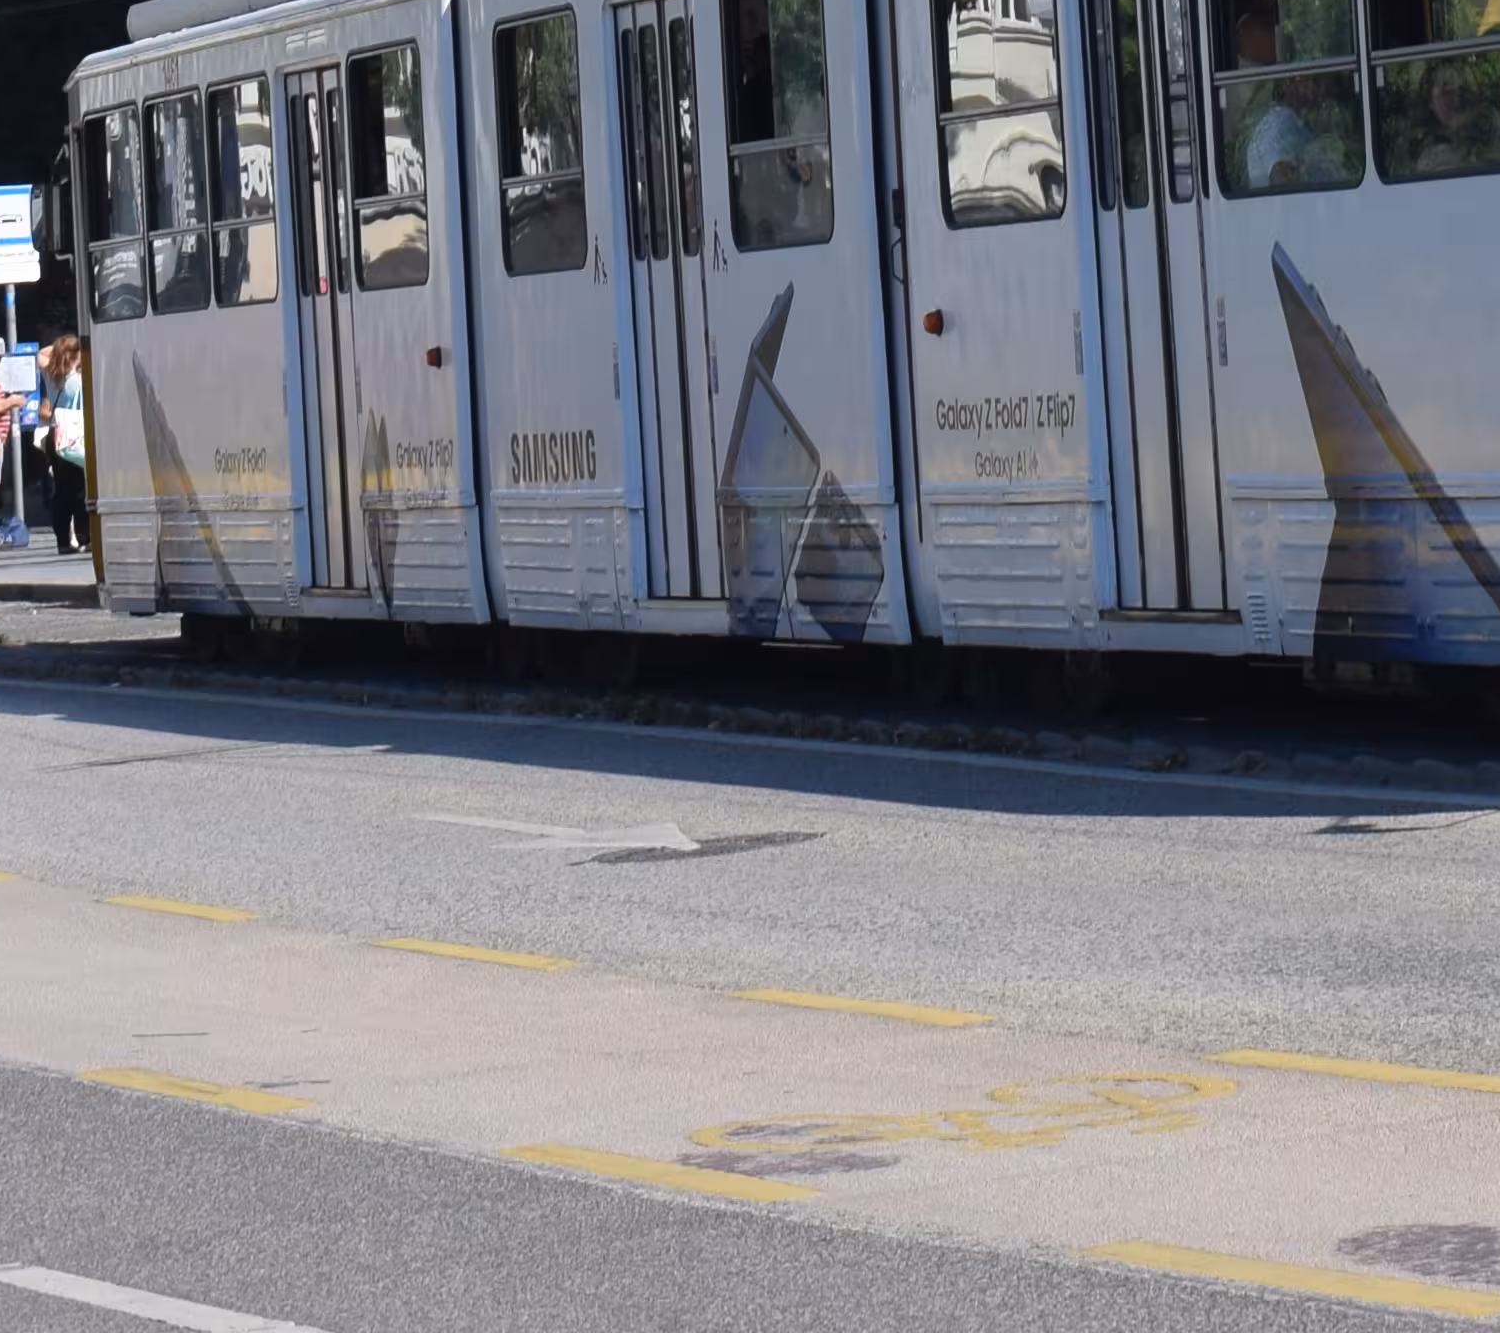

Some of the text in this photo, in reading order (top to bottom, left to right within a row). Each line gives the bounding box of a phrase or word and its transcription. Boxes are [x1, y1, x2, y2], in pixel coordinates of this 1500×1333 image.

[936, 391, 1076, 440] Galaxy Z Fold7 Z Flip7
[214, 447, 241, 480] Galaxy
[396, 440, 427, 475] Galaxy
[510, 429, 597, 484] SAMSUNG
[975, 449, 1027, 484] Galaxy AI
